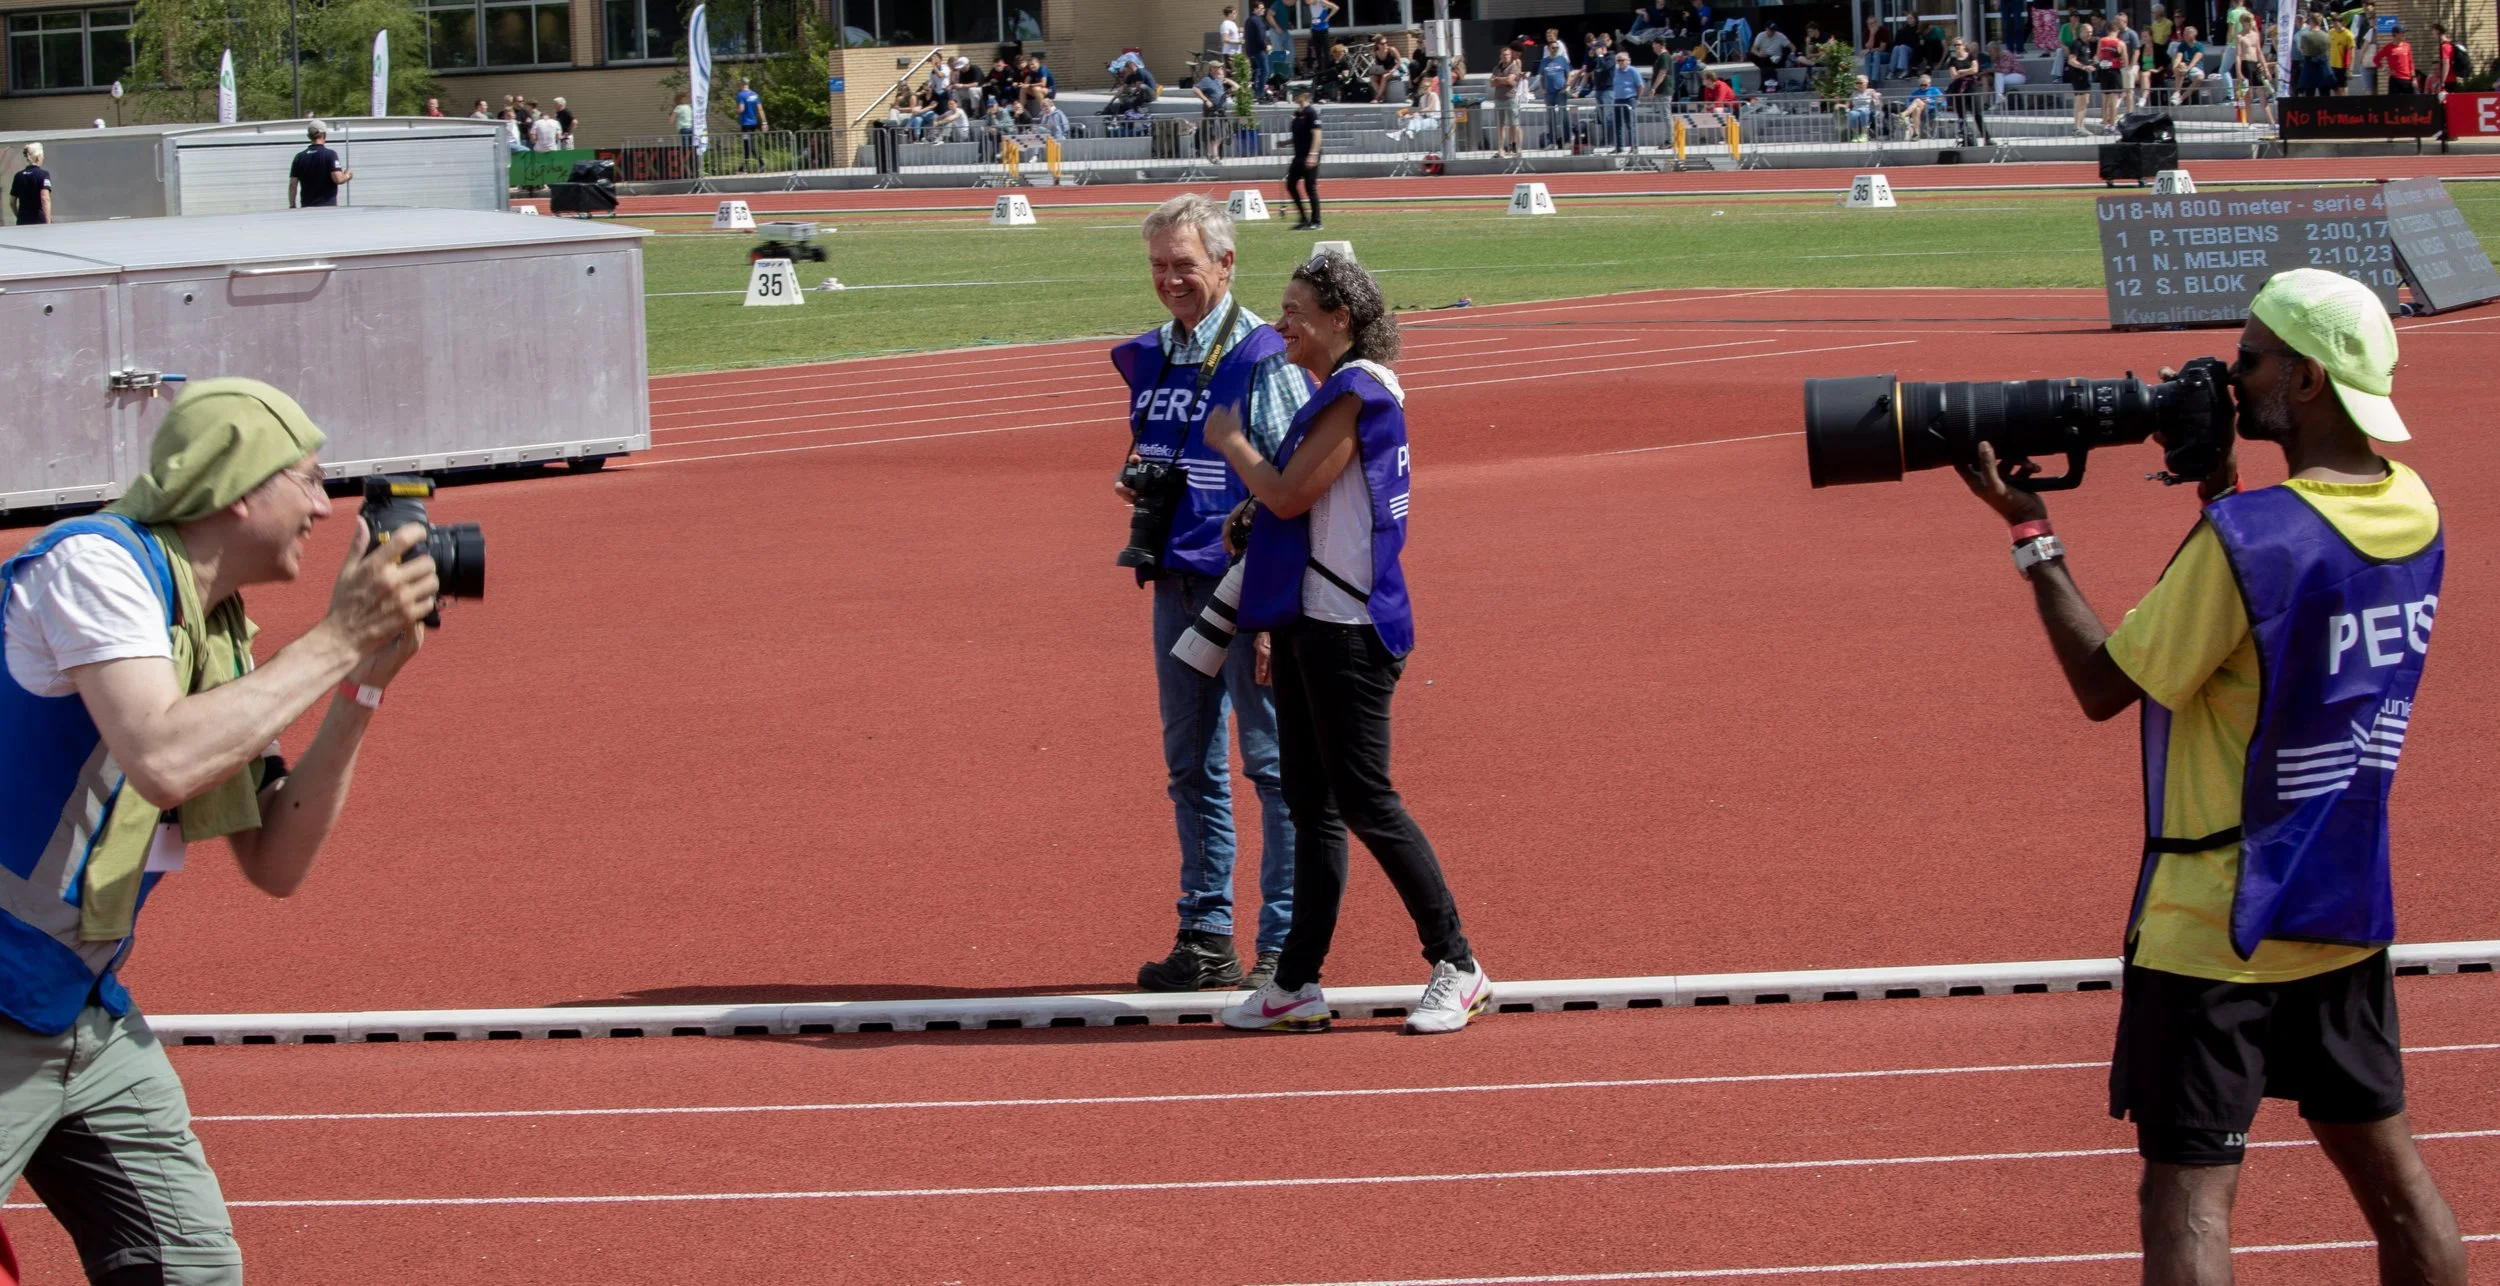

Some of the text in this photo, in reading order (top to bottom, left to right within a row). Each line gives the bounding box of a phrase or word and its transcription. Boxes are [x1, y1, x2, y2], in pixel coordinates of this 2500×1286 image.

[2316, 109, 2365, 127] Human
[2369, 107, 2379, 124] is
[2384, 107, 2433, 125] Limited
[1514, 193, 1528, 209] 40
[1854, 184, 1869, 201] 35
[996, 203, 1008, 218] 50
[1229, 199, 1242, 214] 45
[2099, 201, 2174, 220] U18-M
[2180, 200, 2221, 218] 800
[2228, 198, 2292, 216] meter
[2312, 194, 2366, 212] serie
[2117, 231, 2128, 248] 1
[2305, 221, 2389, 242] 2:00,17
[2112, 254, 2137, 273] 11
[2152, 253, 2179, 271] N.
[2184, 249, 2268, 270] MEIJER
[2308, 245, 2392, 266] 2:10,23
[759, 273, 782, 297] 35
[2115, 279, 2142, 297] 12
[2156, 277, 2179, 295] S.
[2184, 274, 2247, 294] BLOK
[1207, 344, 1222, 368] Nikon
